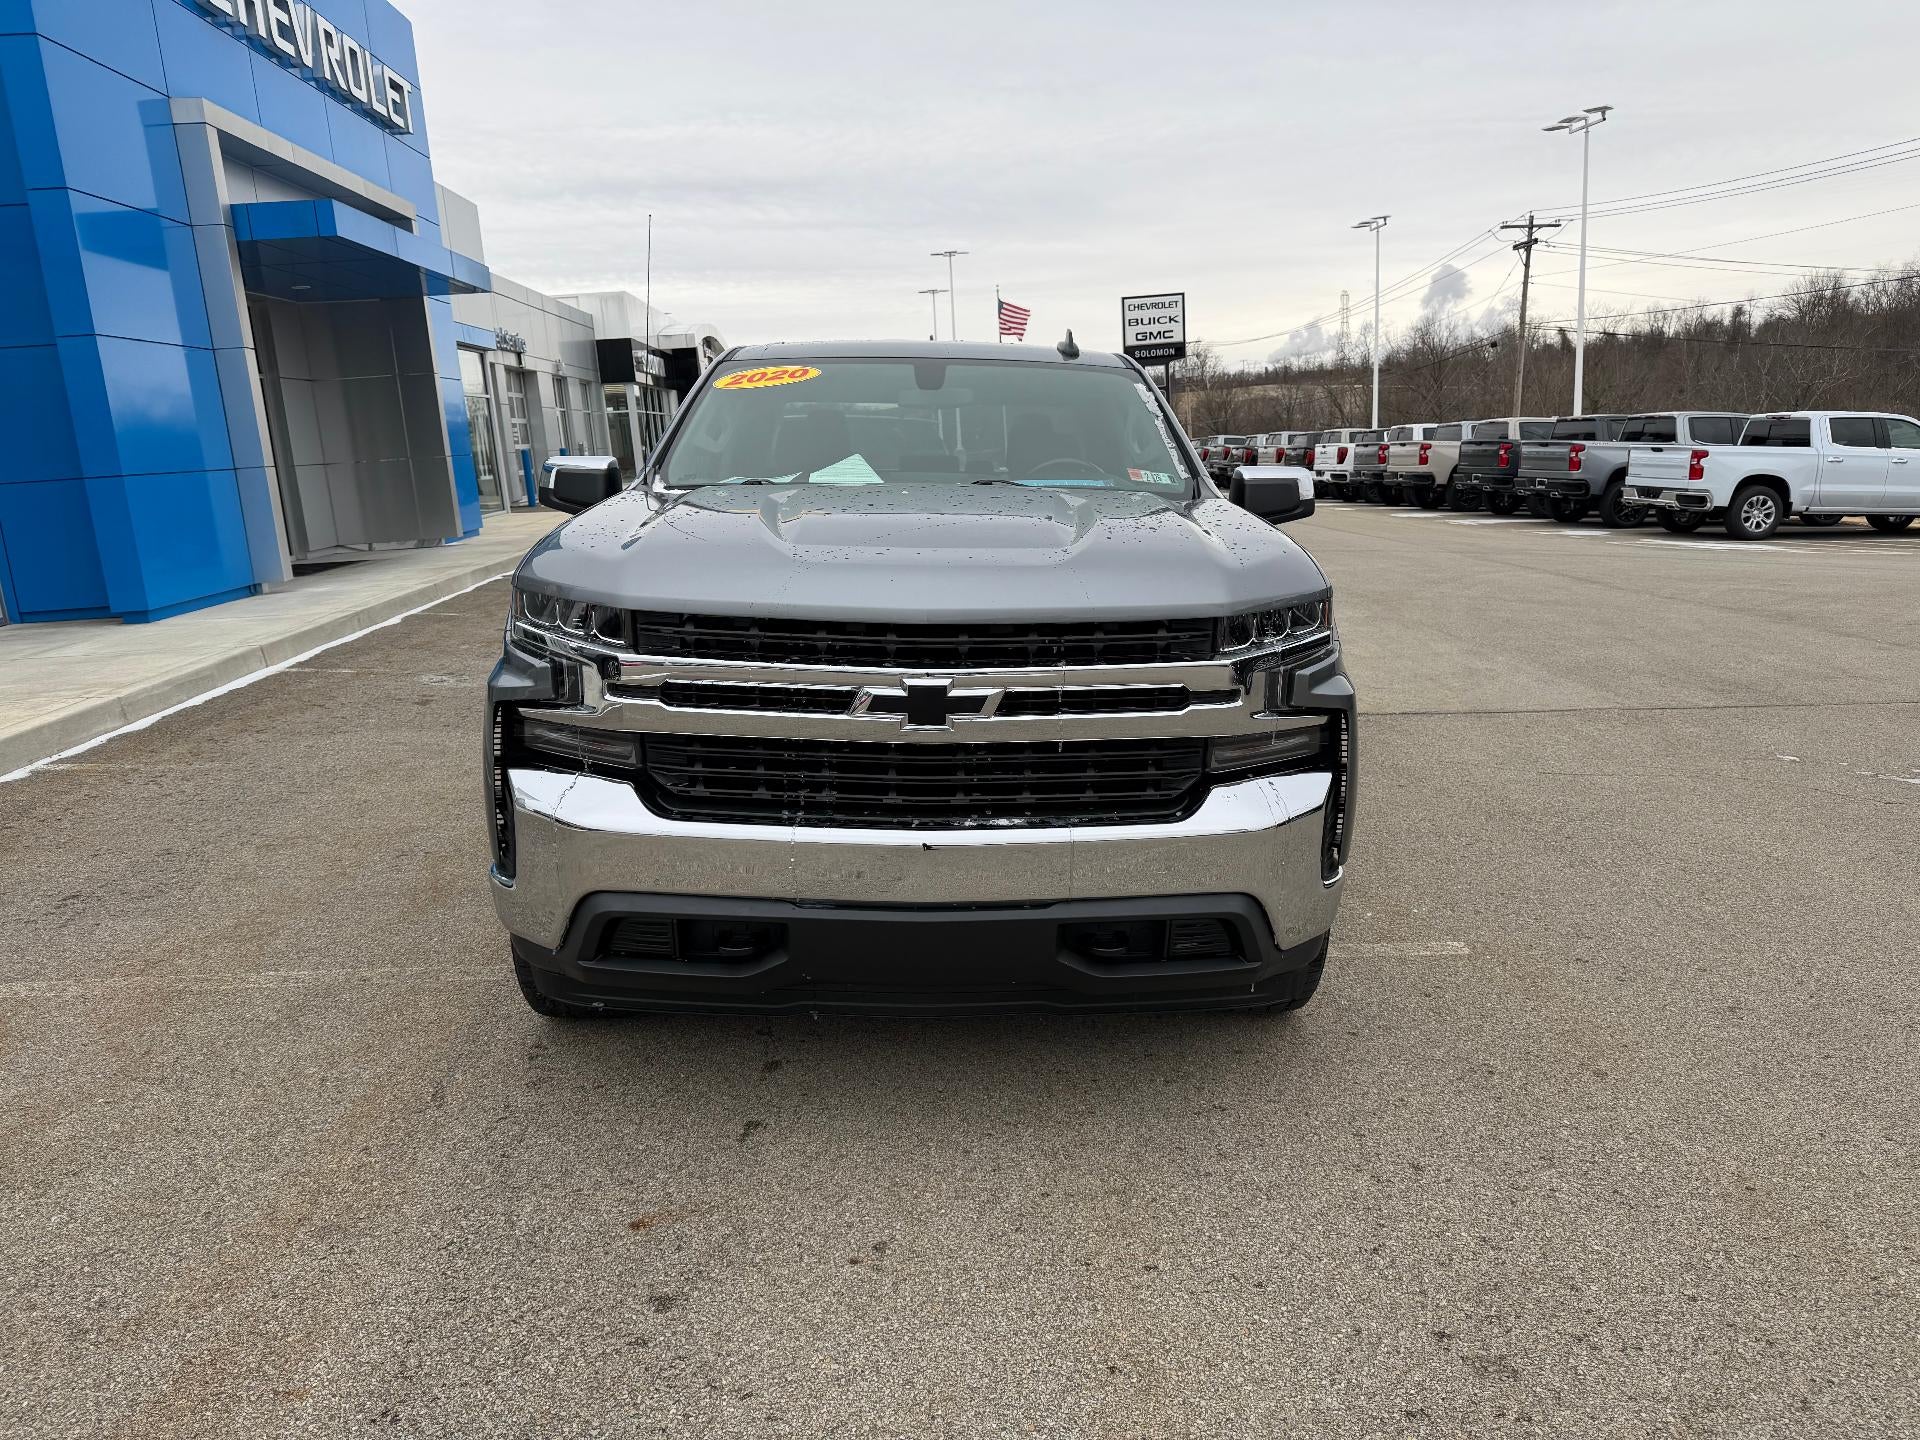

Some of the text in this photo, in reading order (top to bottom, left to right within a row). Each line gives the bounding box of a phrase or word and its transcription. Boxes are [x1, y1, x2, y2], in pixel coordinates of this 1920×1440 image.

[1128, 300, 1180, 311] CHEVROLET
[1128, 315, 1180, 326] BUICK
[1135, 329, 1174, 342] GMC
[1135, 348, 1175, 358] SOLOMON
[723, 368, 810, 387] 2020
